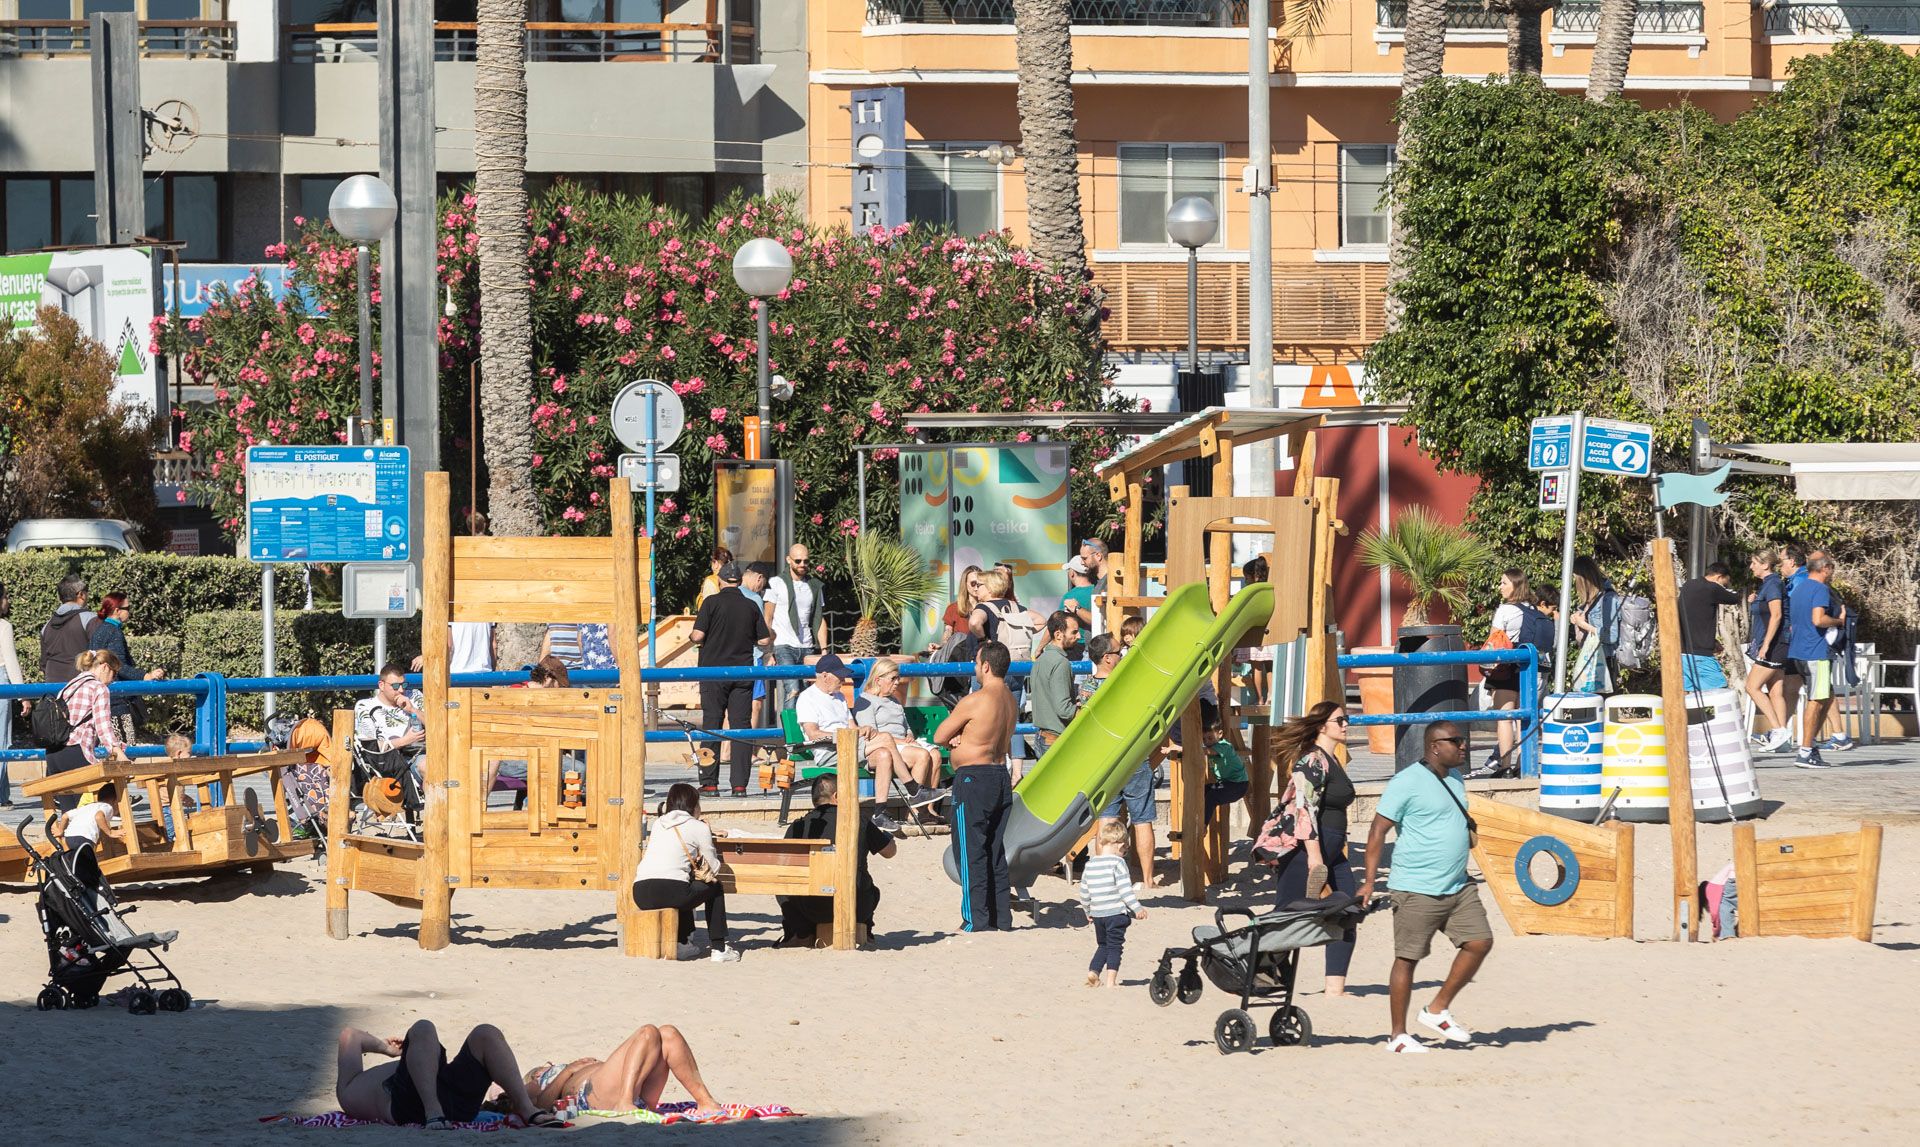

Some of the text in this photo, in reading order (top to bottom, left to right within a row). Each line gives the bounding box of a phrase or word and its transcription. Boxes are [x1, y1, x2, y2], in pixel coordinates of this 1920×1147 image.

[0, 273, 45, 296] enueva
[10, 300, 37, 322] casa
[125, 316, 148, 372] MERLIN
[1587, 441, 1612, 449] ACCESO
[303, 453, 340, 462] POSTIGUET
[1546, 446, 1554, 463] 2
[1621, 444, 1635, 469] 2
[915, 522, 935, 535] teika
[990, 520, 1029, 534] teika
